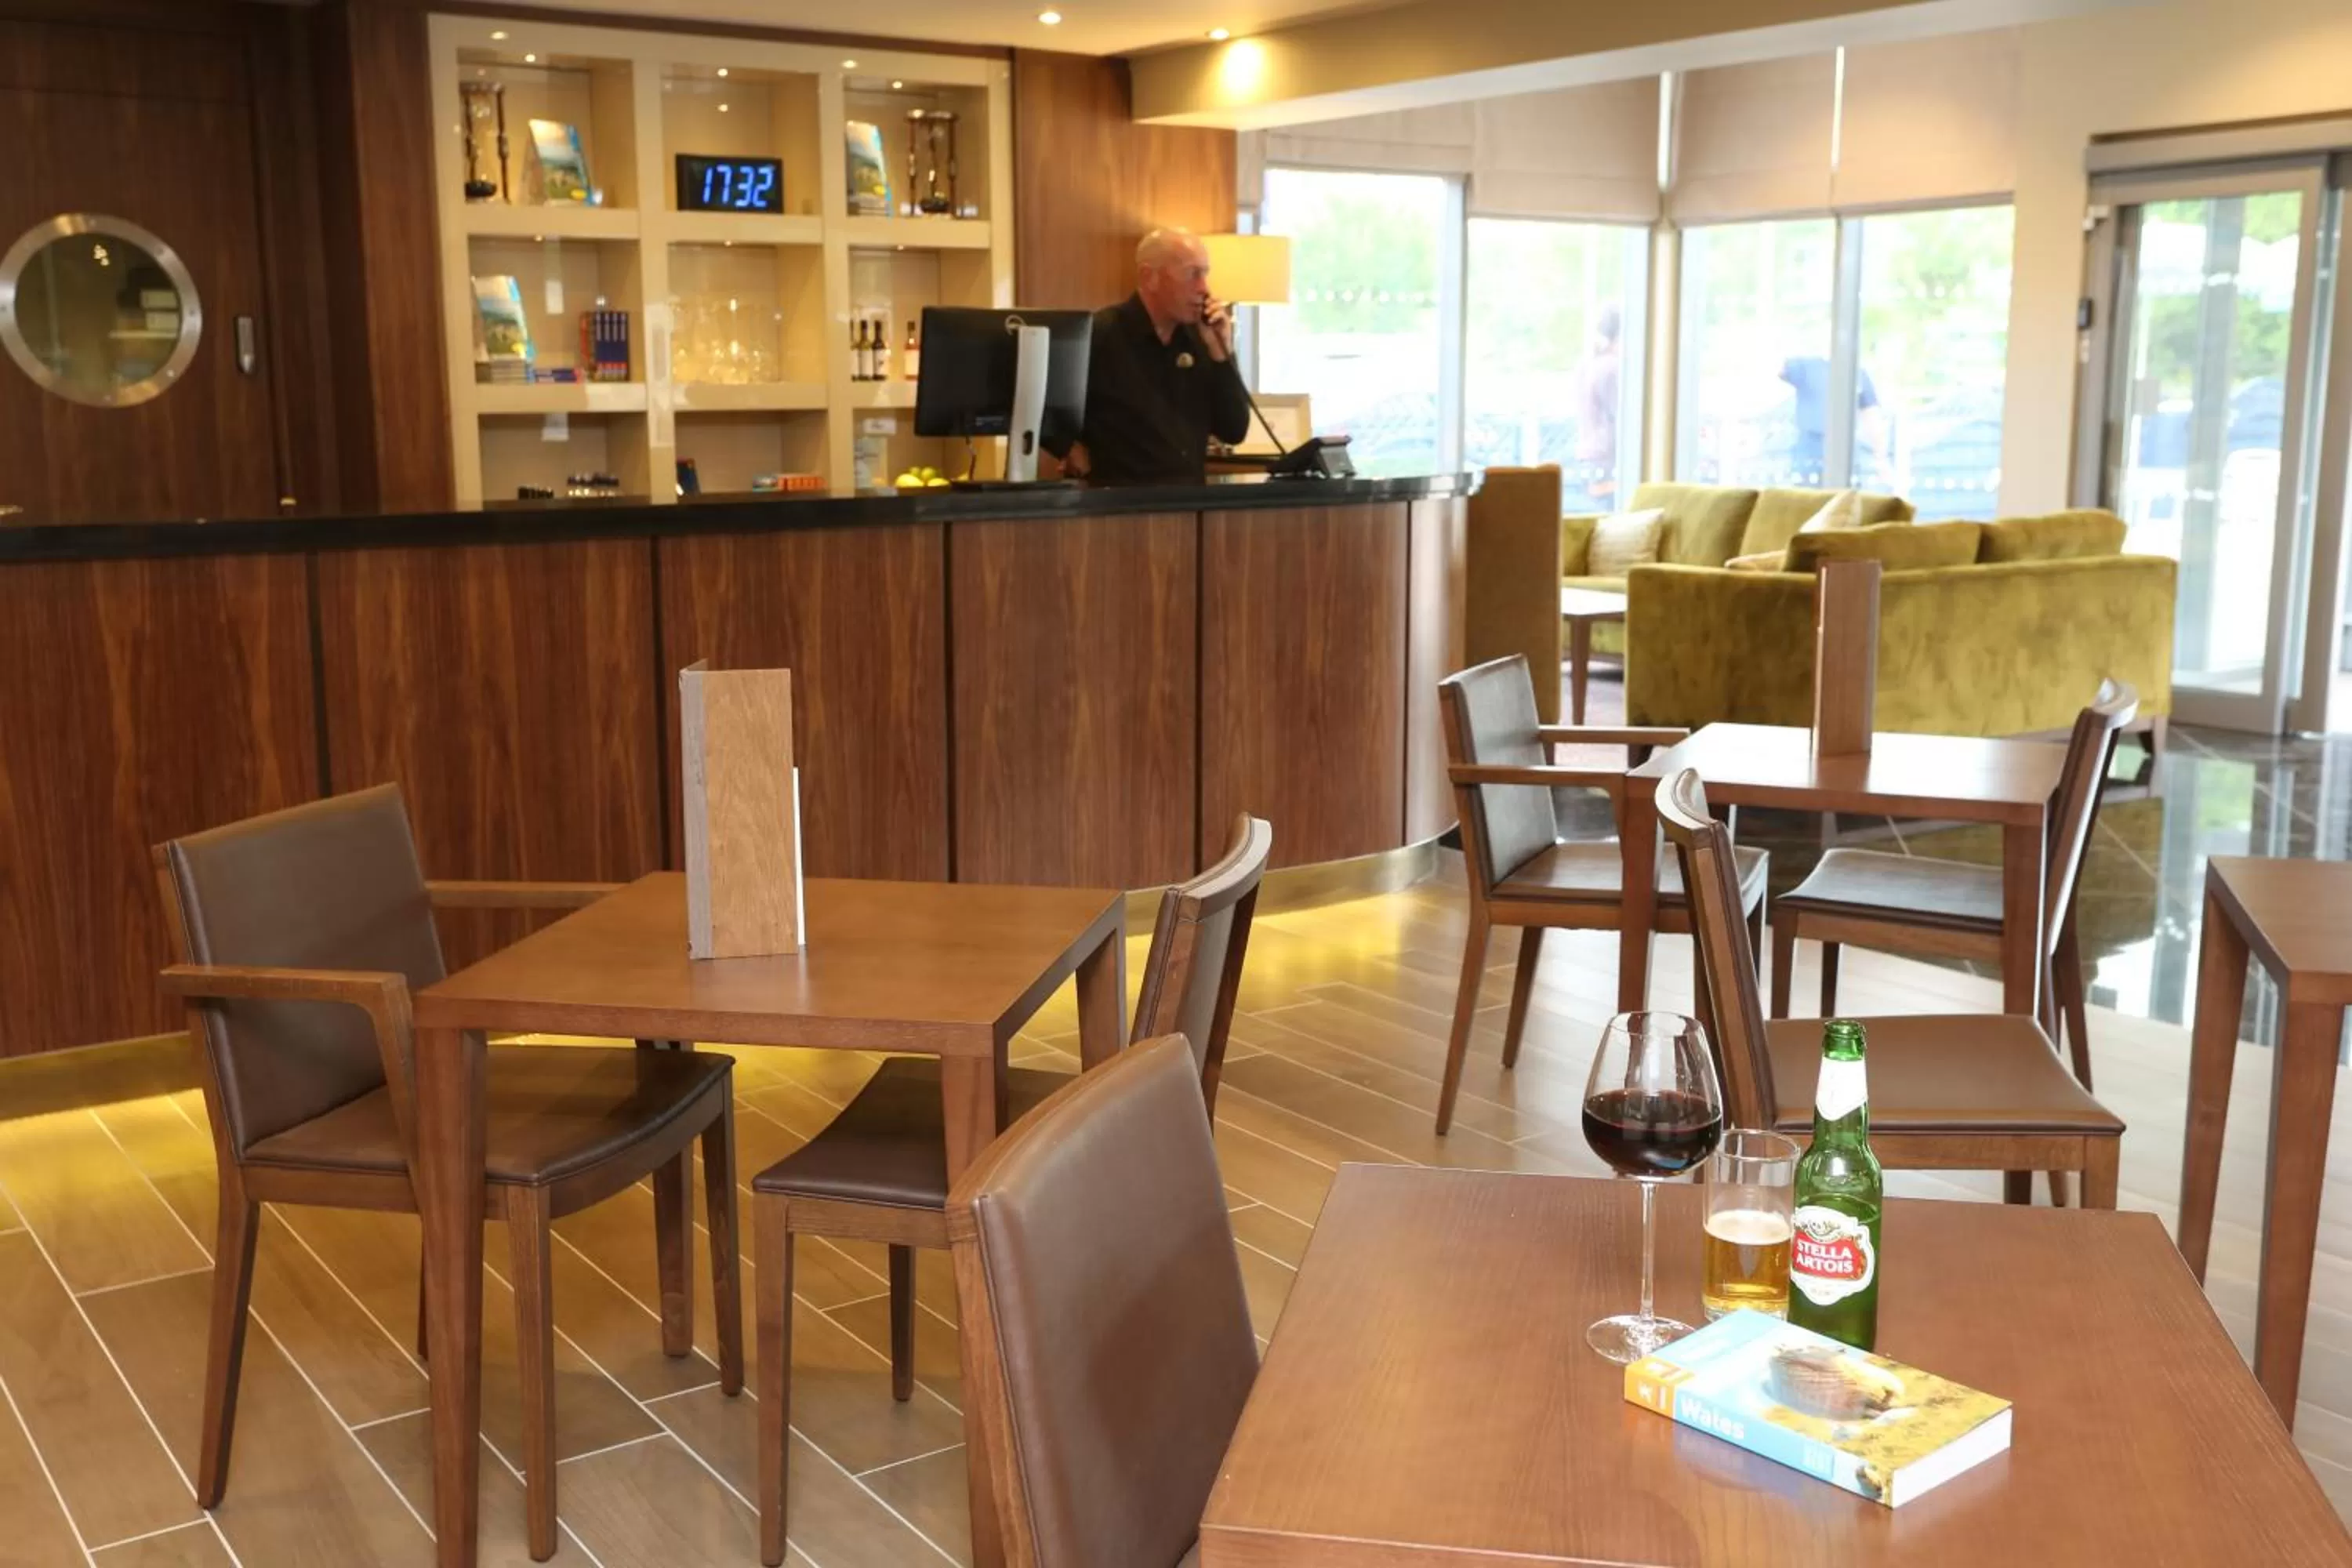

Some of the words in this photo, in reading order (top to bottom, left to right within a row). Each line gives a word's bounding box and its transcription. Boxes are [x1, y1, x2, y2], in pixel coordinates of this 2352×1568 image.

[702, 164, 775, 207] 1732
[1796, 1238, 1853, 1259] STELLA
[1796, 1253, 1853, 1274] ARTOIS
